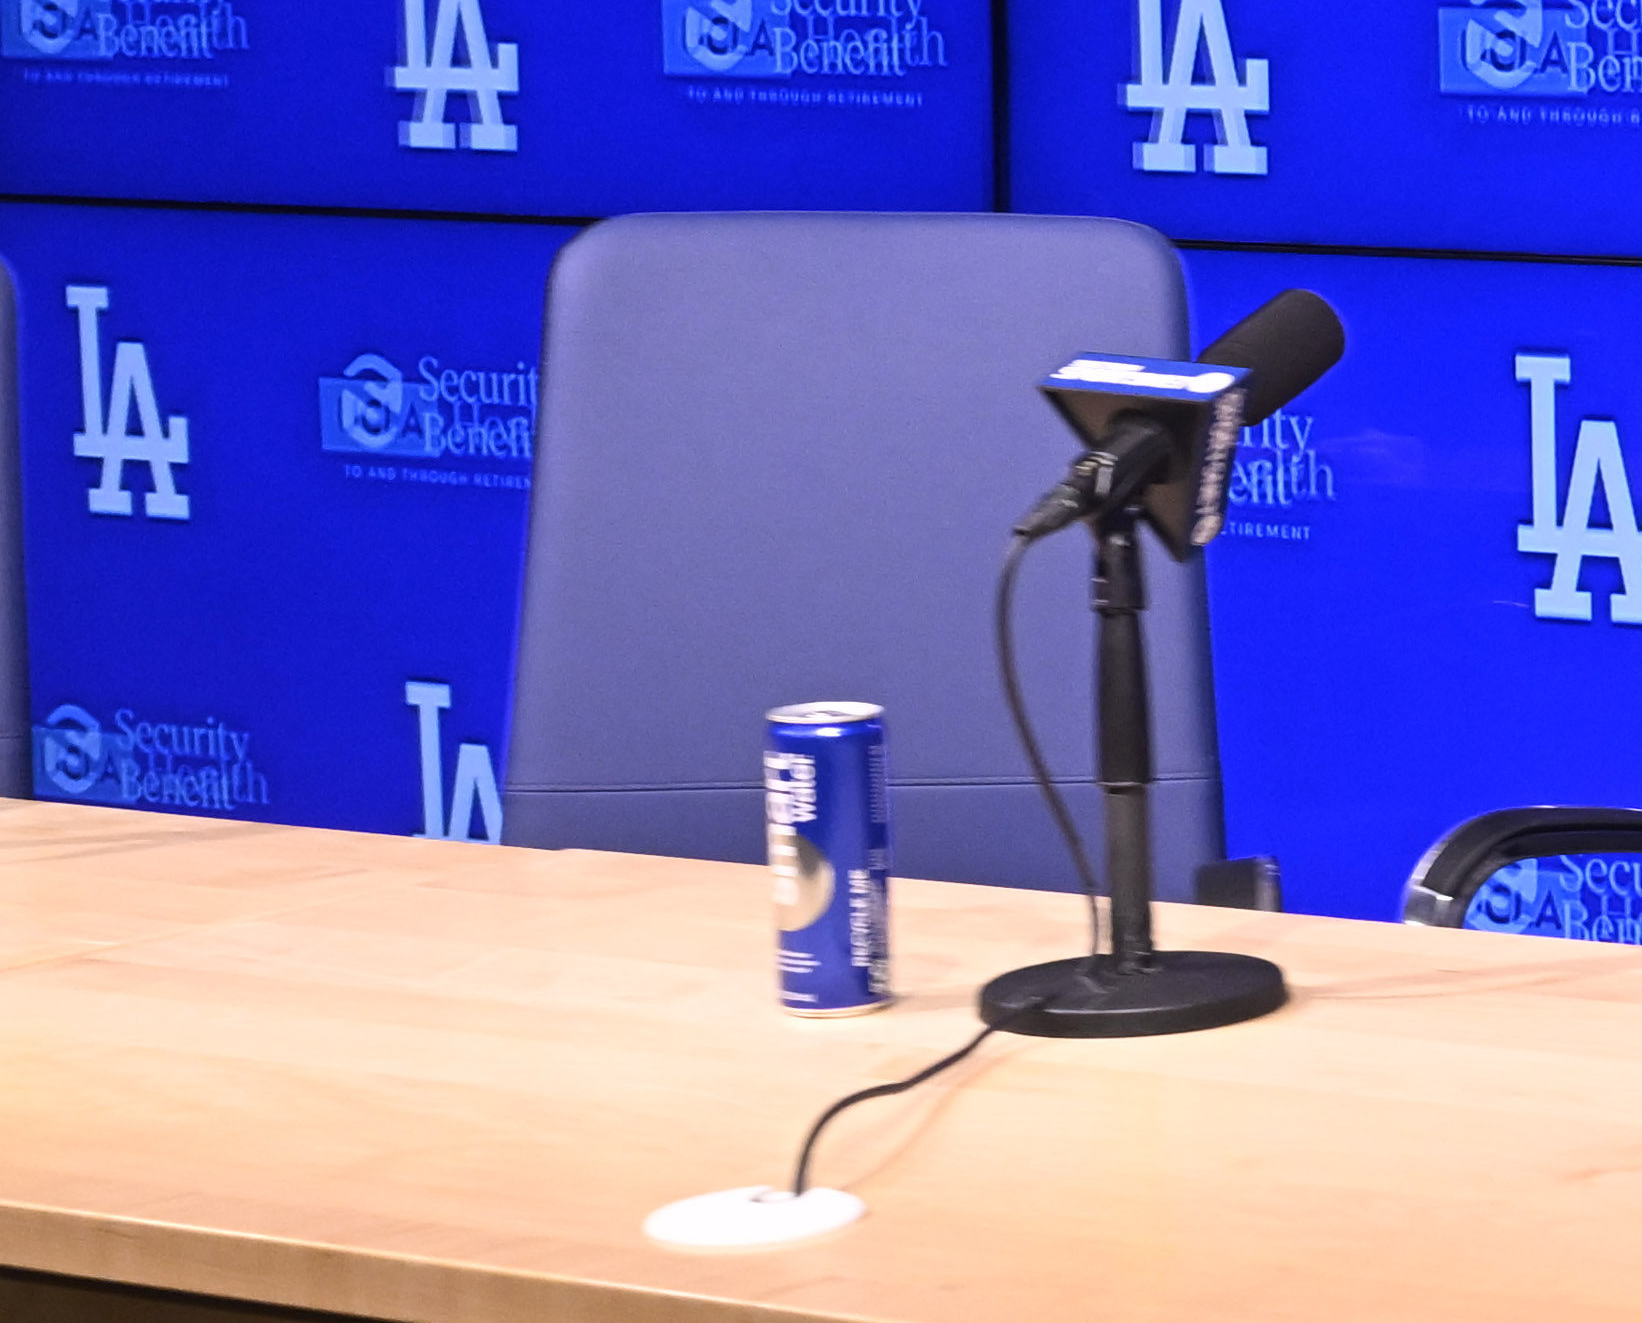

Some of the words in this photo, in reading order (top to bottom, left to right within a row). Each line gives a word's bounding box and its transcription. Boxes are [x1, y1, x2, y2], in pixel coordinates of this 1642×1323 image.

[66, 286, 190, 520] LA
[418, 356, 538, 406] Securit
[424, 412, 531, 457] Benefi
[1221, 522, 1310, 540] TIREMENT
[115, 709, 249, 760] Security
